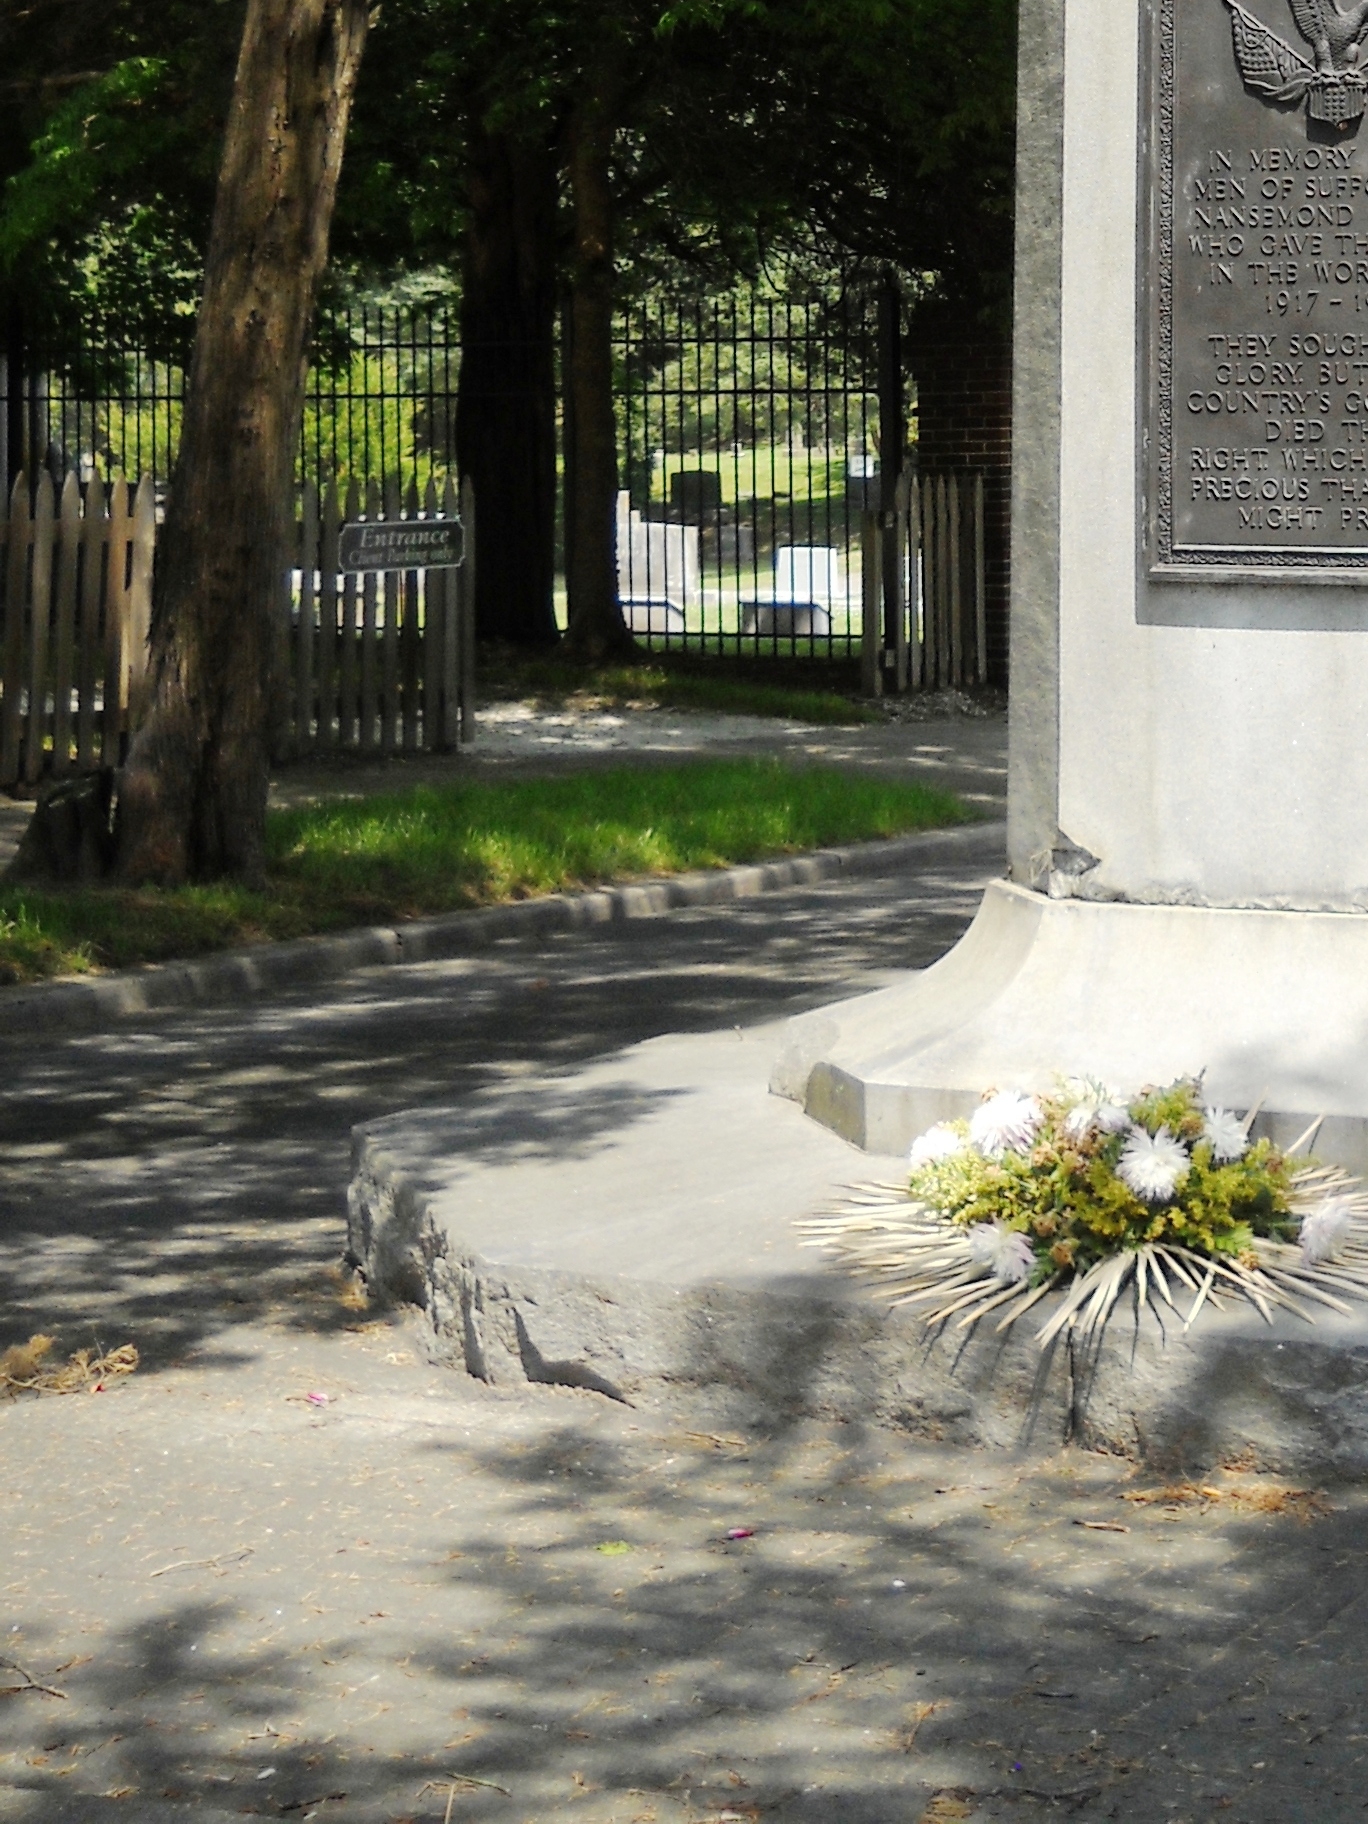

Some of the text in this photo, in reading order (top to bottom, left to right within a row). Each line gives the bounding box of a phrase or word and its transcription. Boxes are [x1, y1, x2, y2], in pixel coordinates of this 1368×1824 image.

[1209, 149, 1232, 172] IN
[1250, 147, 1356, 172] MEMORY
[1194, 177, 1246, 201] MEN
[1260, 176, 1294, 199] OF
[1194, 204, 1353, 229] NANSEMOND
[1188, 234, 1245, 258] WHO
[1260, 233, 1323, 256] GAVE
[1209, 261, 1234, 285] IN
[1248, 261, 1299, 285] THE
[1265, 289, 1320, 317] 1917
[1208, 334, 1277, 357] THEY
[1187, 390, 1332, 414] COUNTRY'S
[1265, 419, 1325, 443] DIED
[1281, 447, 1367, 471] WHICH
[1190, 477, 1310, 501] PRECIOUS
[360, 528, 450, 547] Entrance
